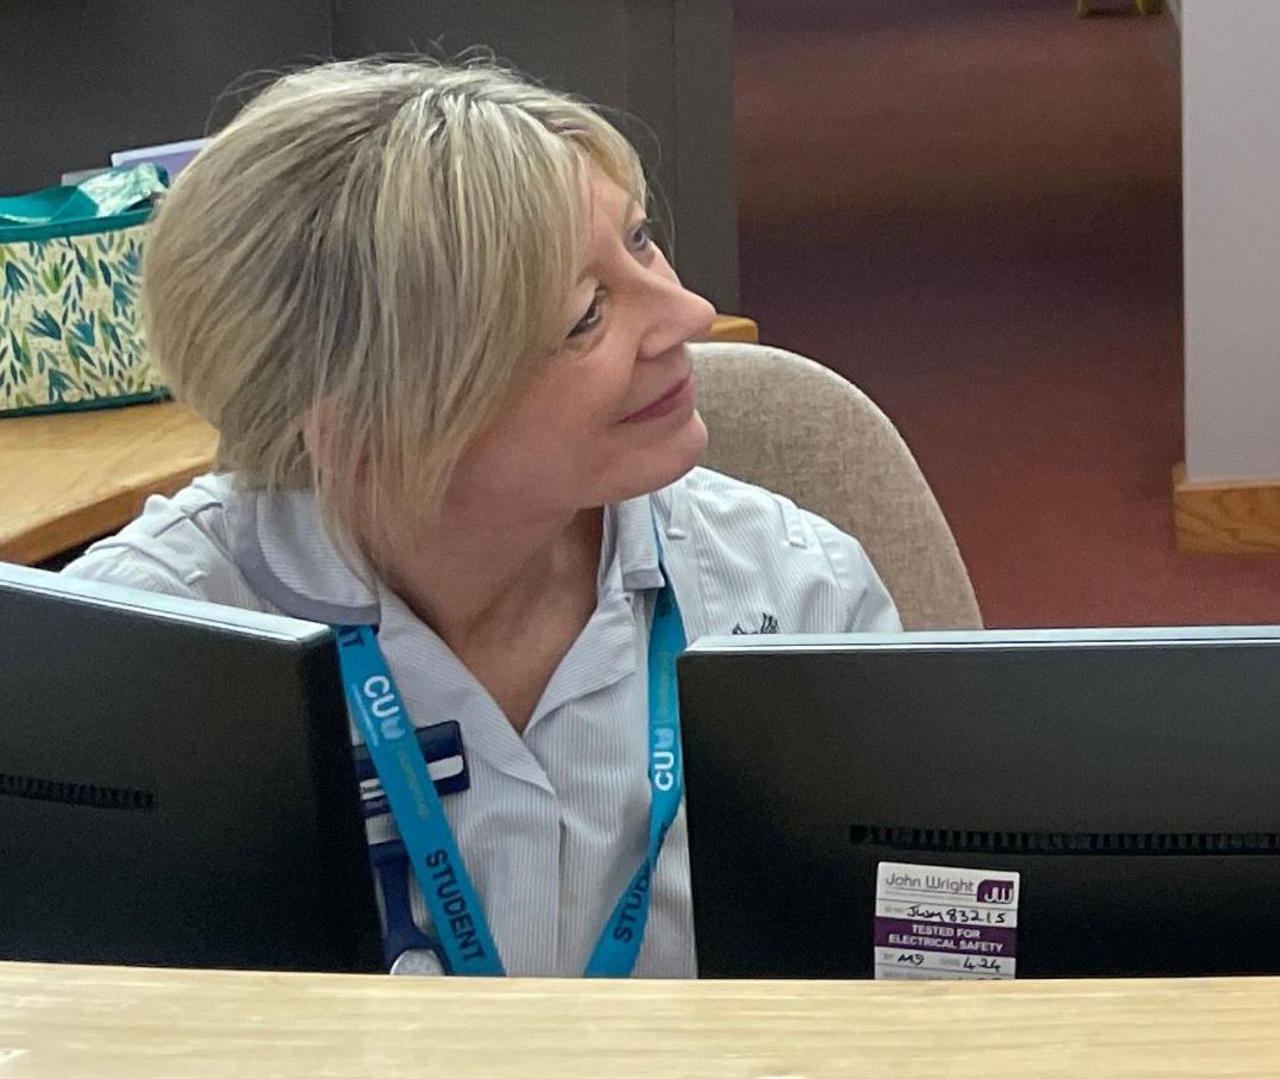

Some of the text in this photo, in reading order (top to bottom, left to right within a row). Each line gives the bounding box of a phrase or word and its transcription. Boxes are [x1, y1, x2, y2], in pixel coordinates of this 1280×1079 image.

[885, 873, 975, 893] John Wright
[425, 848, 488, 962] STUDENT
[911, 924, 981, 939] TESTED FOR
[888, 933, 1003, 953] ELECTRICAL SAFETY
